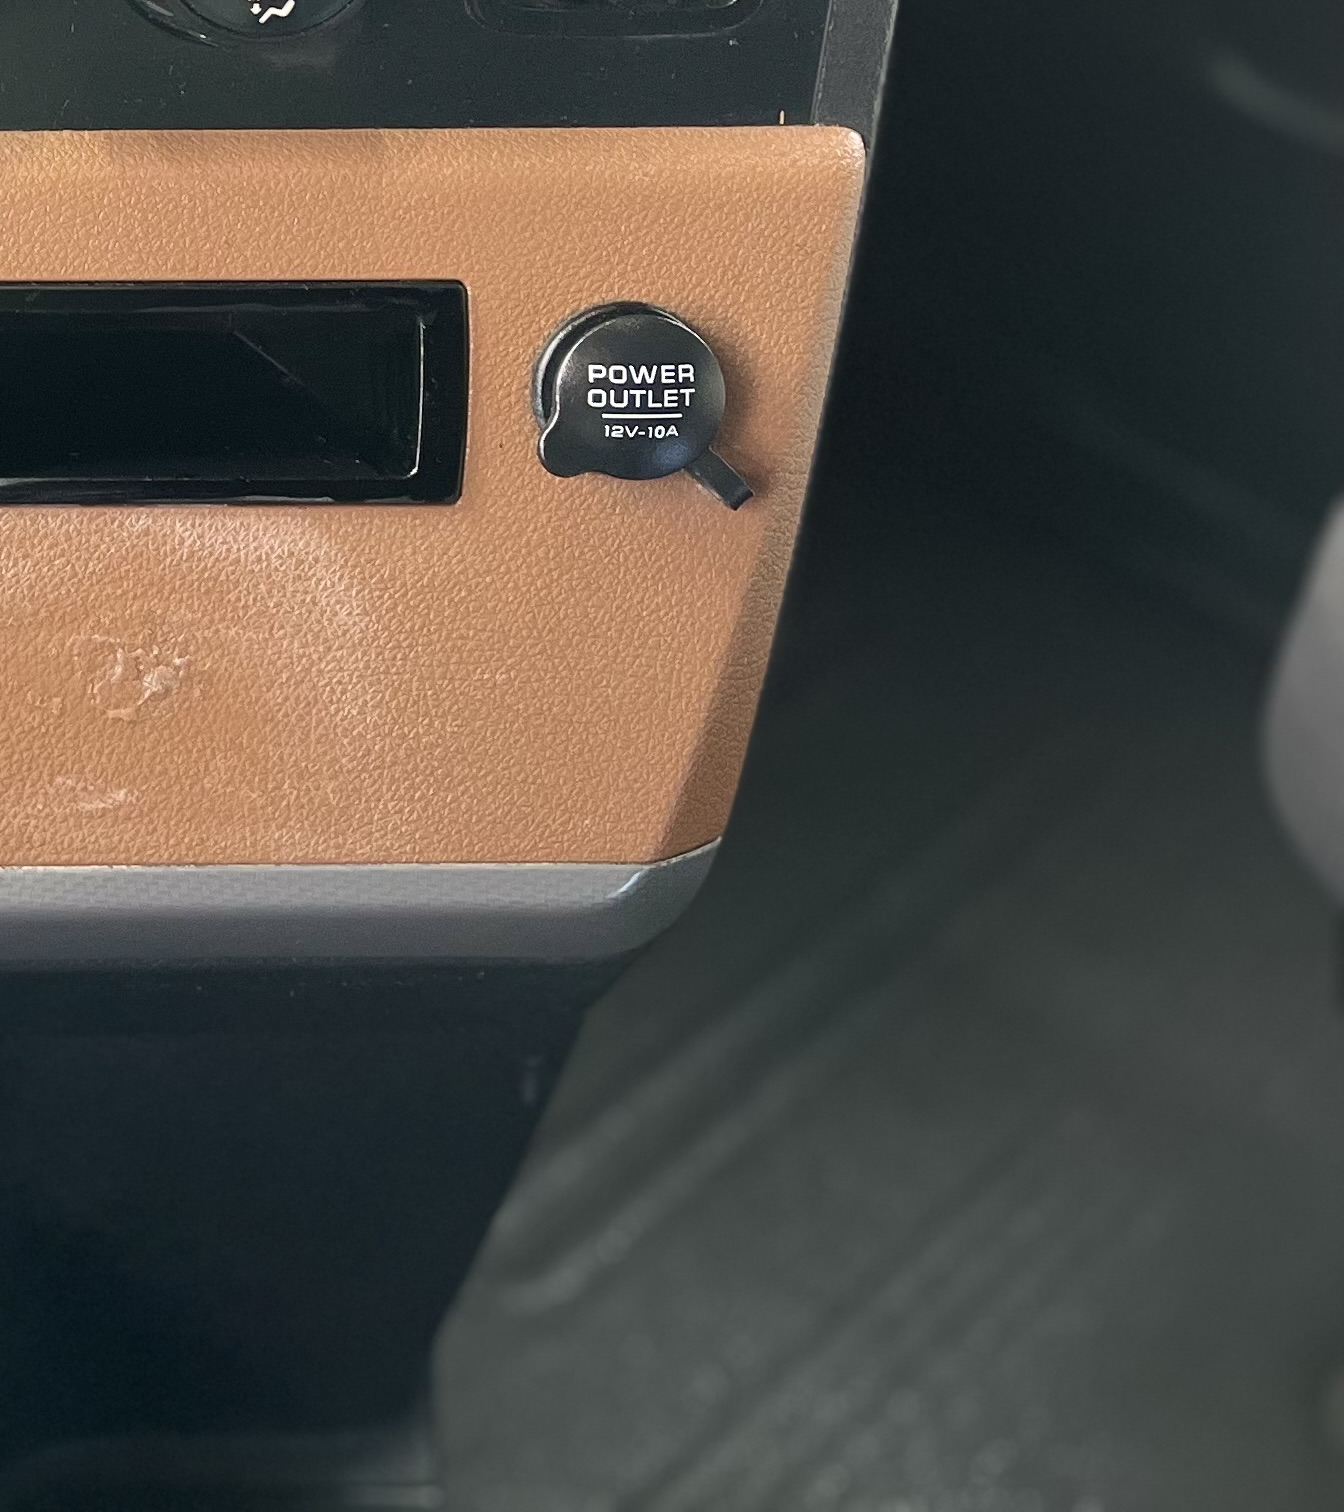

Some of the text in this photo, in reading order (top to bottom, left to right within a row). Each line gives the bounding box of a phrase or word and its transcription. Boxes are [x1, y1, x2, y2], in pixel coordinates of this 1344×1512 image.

[587, 363, 695, 385] POWER
[587, 388, 696, 408] OUTLET
[604, 424, 679, 439] 12V-10A
